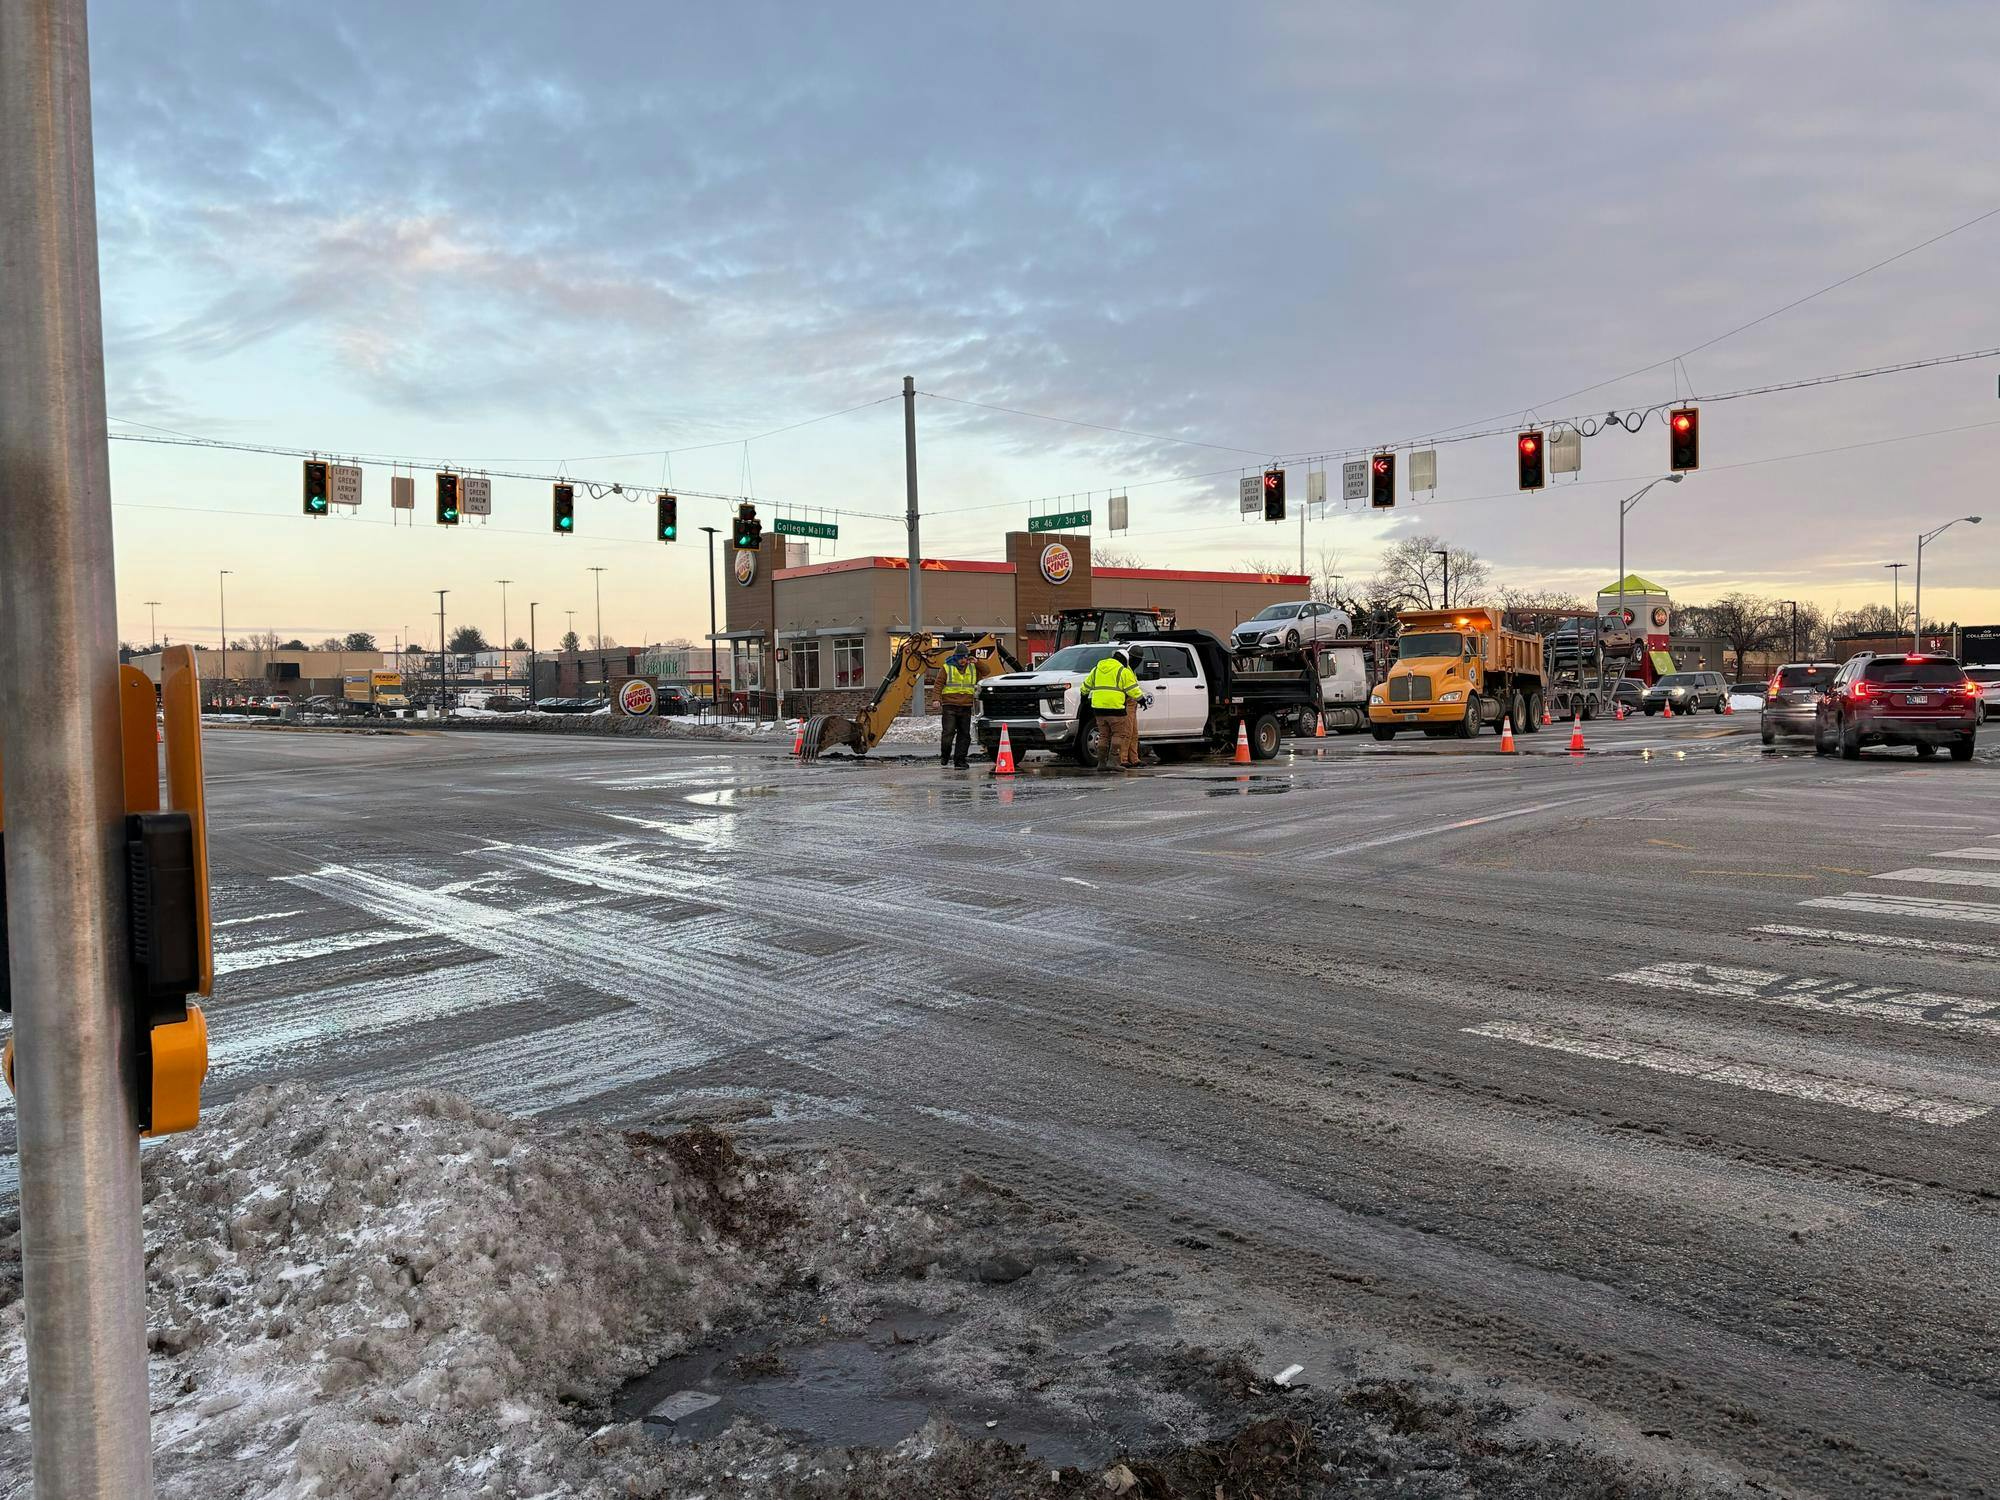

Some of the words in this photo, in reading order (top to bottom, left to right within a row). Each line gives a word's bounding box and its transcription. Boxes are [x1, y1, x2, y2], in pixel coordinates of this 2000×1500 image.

[337, 476, 357, 484] GREEN
[1348, 472, 1363, 480] GREEN
[1347, 480, 1364, 488] ARROW
[336, 485, 357, 493] ARROW
[469, 488, 486, 496] GREEN
[339, 493, 355, 501] ONLY
[468, 496, 487, 504] ARROW
[470, 504, 485, 512] ONLY
[1030, 520, 1040, 529] SR
[1044, 519, 1053, 527] 46
[1065, 516, 1076, 525] 3rd
[1081, 514, 1089, 523] St
[777, 522, 806, 534] College
[808, 525, 824, 535] Mall
[826, 527, 836, 536] Rd
[1046, 552, 1068, 564] BURGER
[1047, 559, 1070, 573] KING
[975, 648, 988, 659] CAT
[625, 687, 651, 700] BURGER
[626, 693, 652, 708] KING
